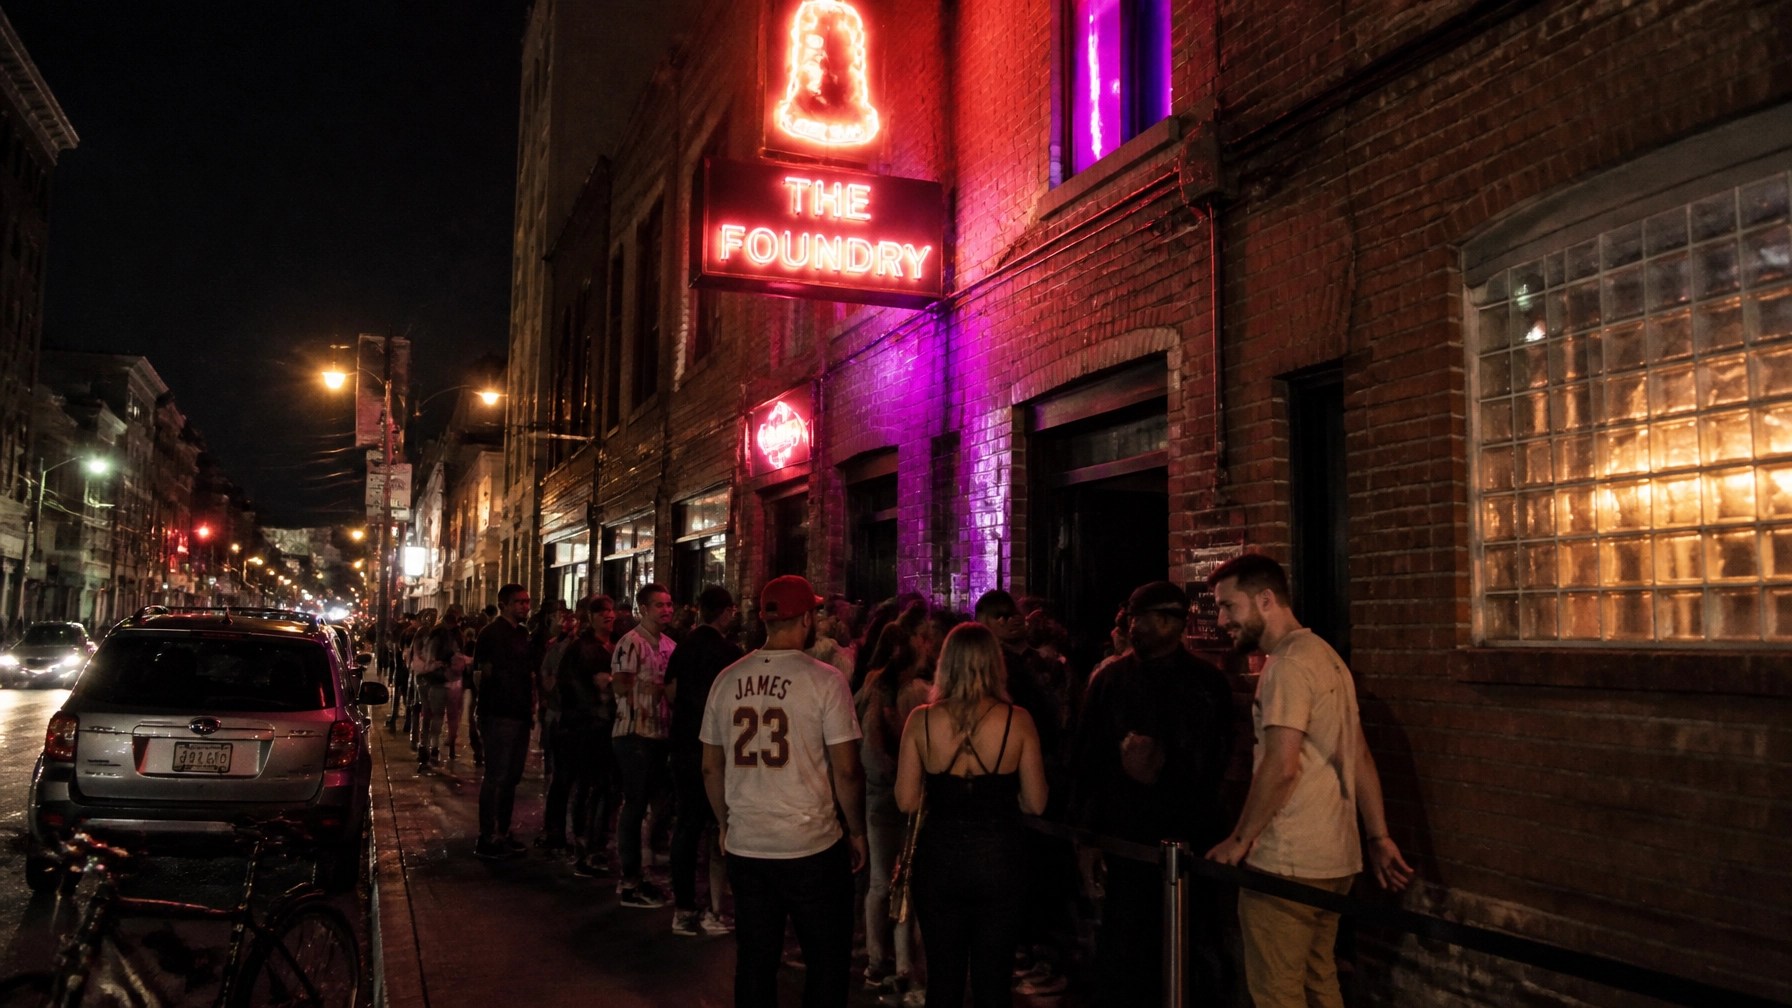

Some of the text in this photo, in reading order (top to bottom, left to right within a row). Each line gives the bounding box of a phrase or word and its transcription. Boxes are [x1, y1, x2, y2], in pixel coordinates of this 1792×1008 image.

[783, 176, 872, 220] THE
[719, 224, 932, 280] FOUNDRY
[735, 675, 792, 700] JAMES
[733, 707, 789, 768] 23
